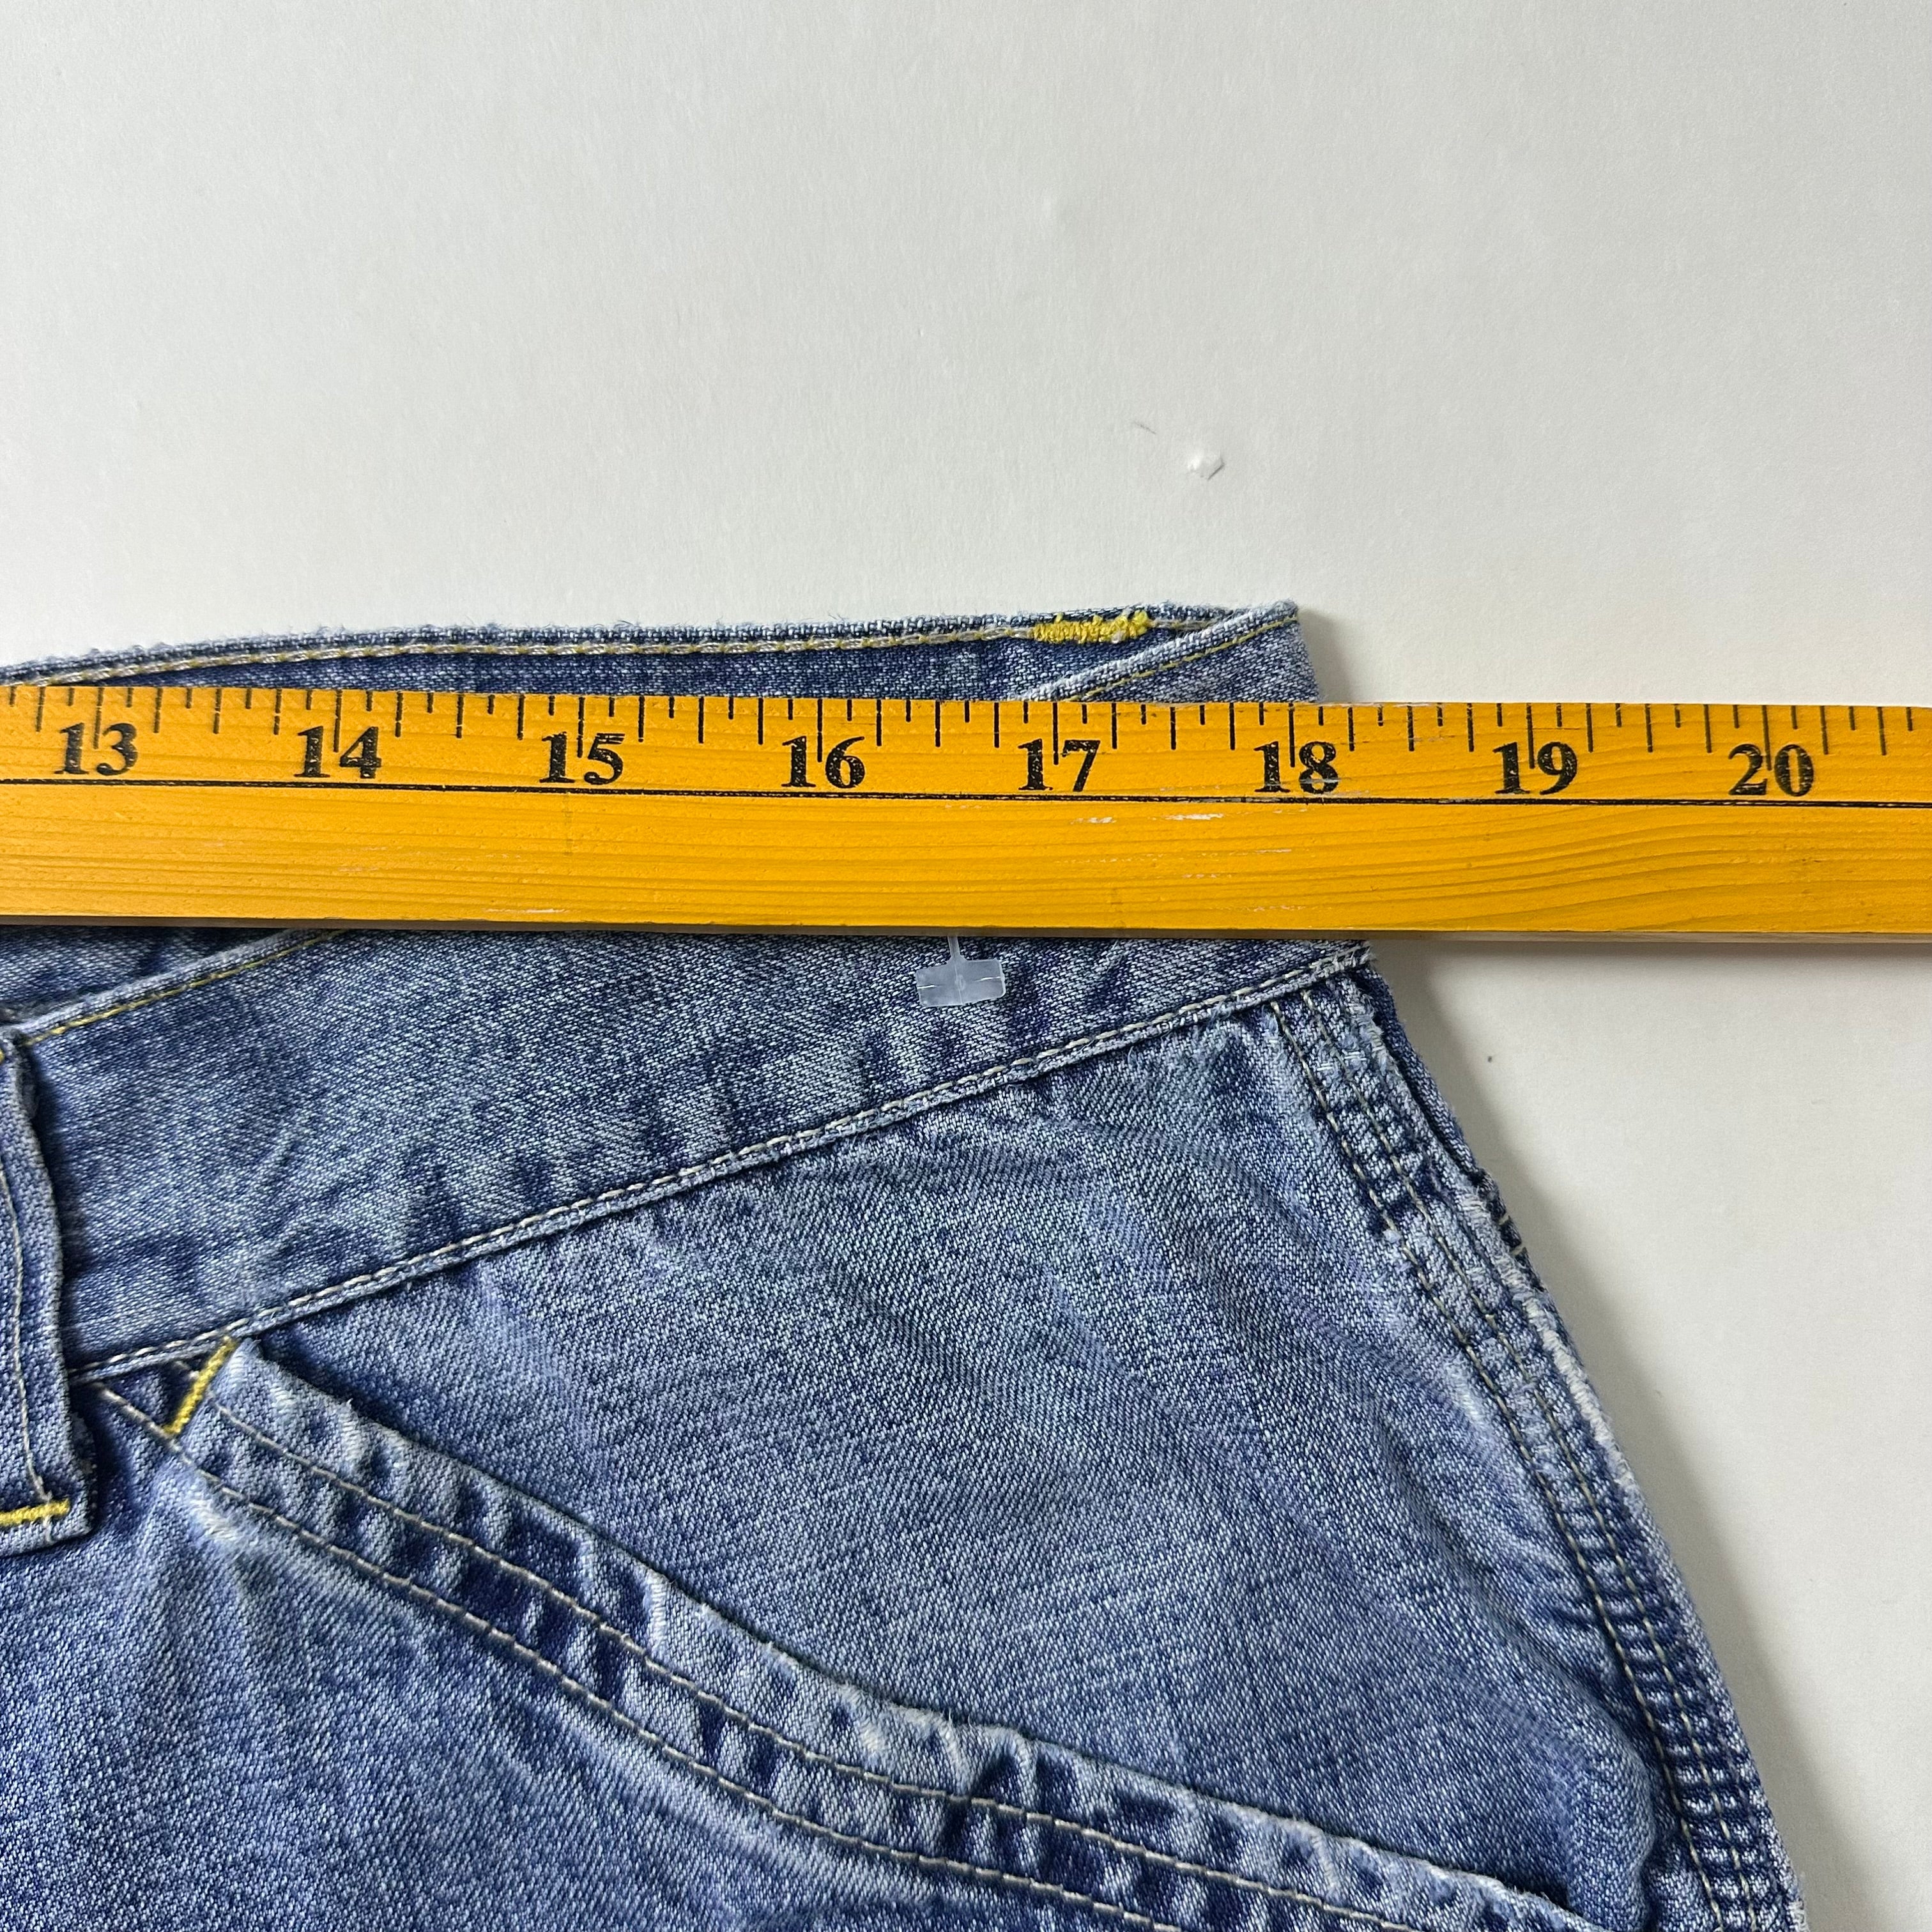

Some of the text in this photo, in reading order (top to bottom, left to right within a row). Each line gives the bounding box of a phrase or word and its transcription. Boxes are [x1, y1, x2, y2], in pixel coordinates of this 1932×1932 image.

[54, 723, 1815, 797] 13 14 15 16 17 18 19 20
